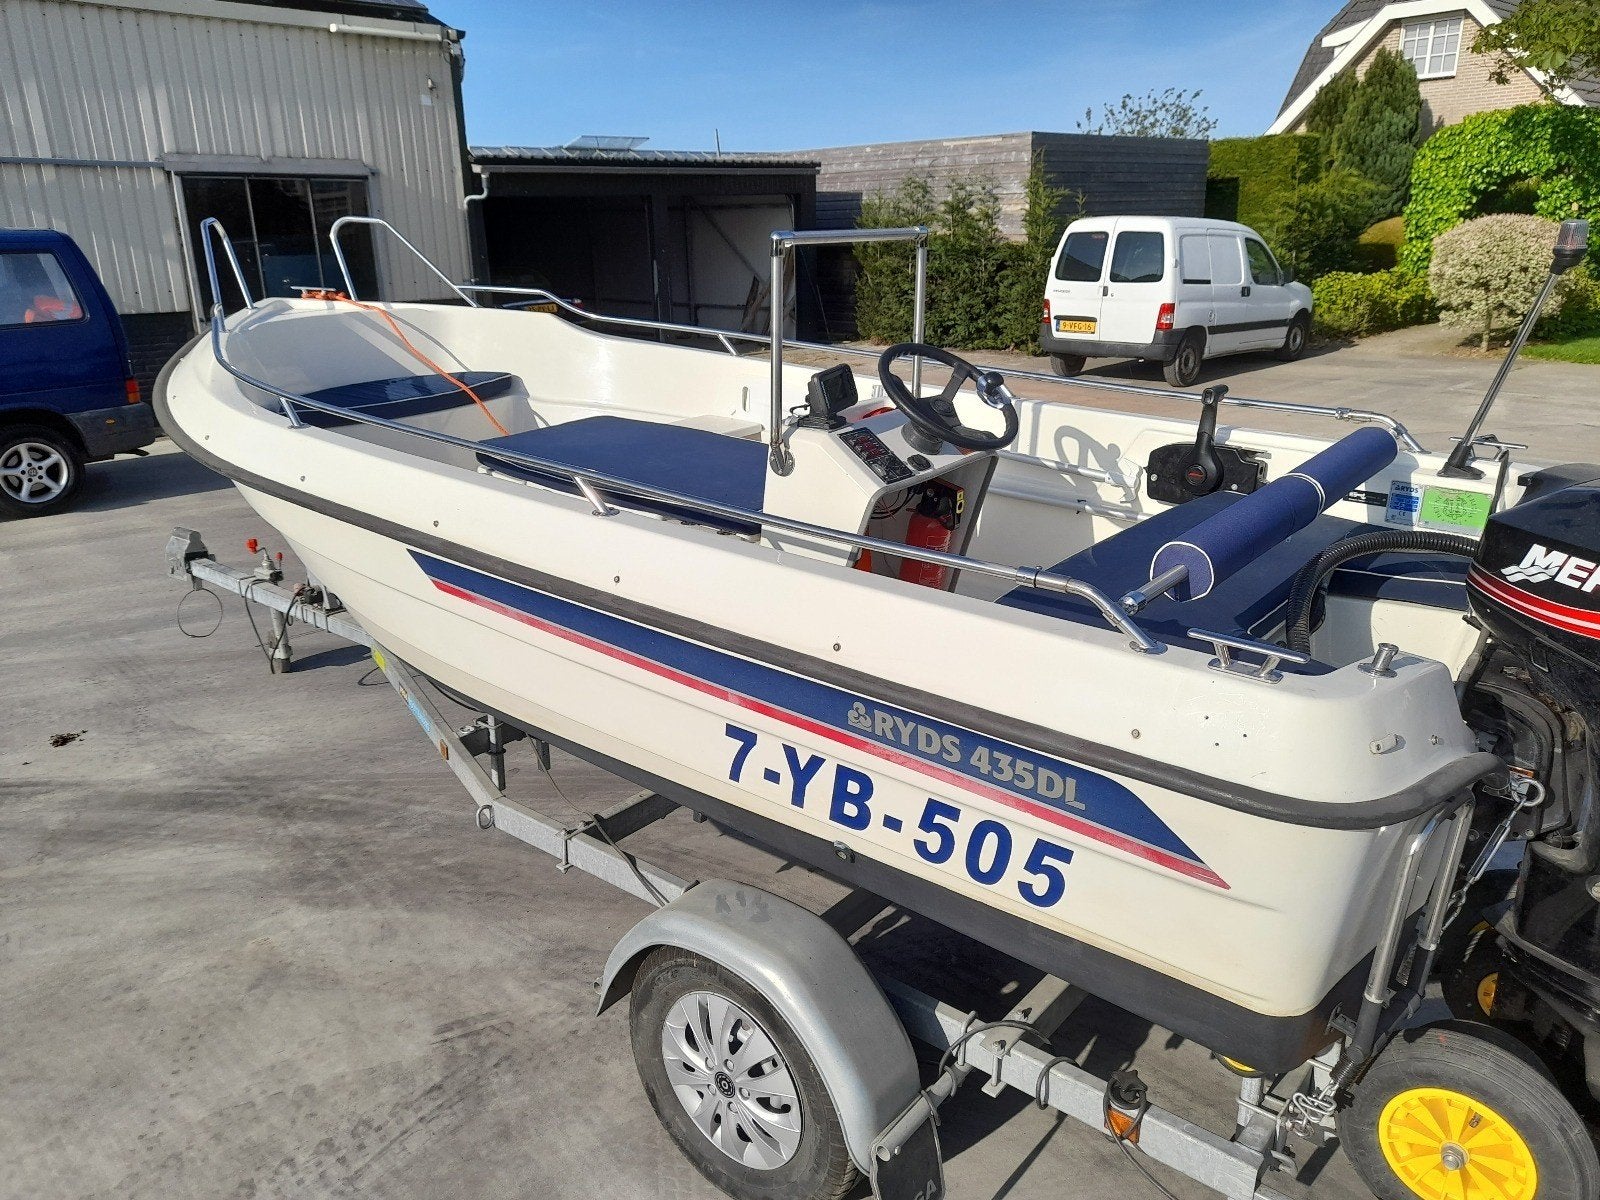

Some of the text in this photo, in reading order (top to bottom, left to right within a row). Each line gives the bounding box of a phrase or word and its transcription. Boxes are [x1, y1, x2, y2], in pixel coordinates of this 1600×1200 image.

[1401, 485, 1419, 494] RYDS
[873, 709, 1086, 811] RYDS 435DL
[725, 723, 1075, 908] 7-YB-505
